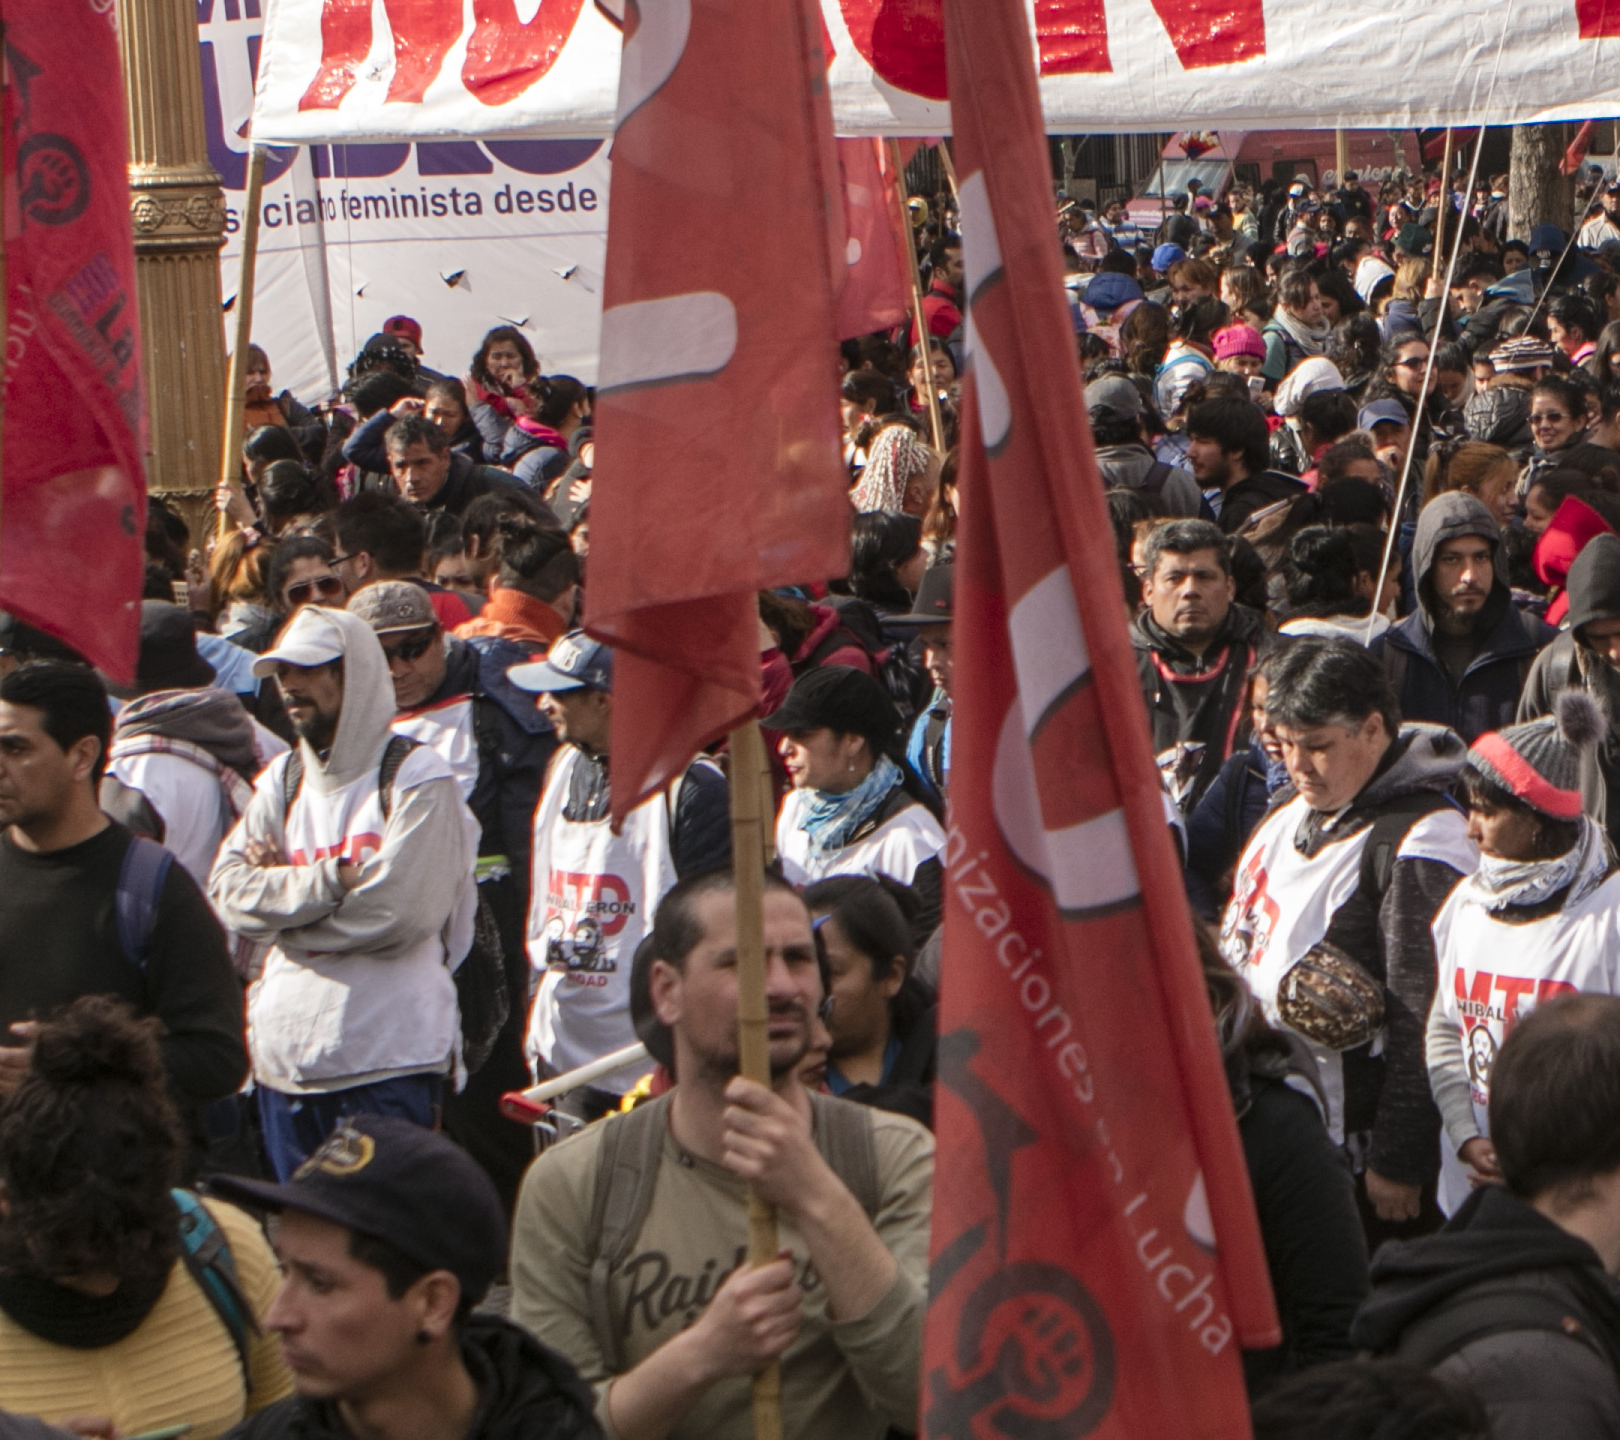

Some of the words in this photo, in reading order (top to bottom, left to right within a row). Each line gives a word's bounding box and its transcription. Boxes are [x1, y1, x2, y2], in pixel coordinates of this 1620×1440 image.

[340, 185, 483, 224] feminista
[494, 181, 598, 215] desde
[1454, 967, 1580, 1038] MT
[1457, 998, 1509, 1023] NIBAL
